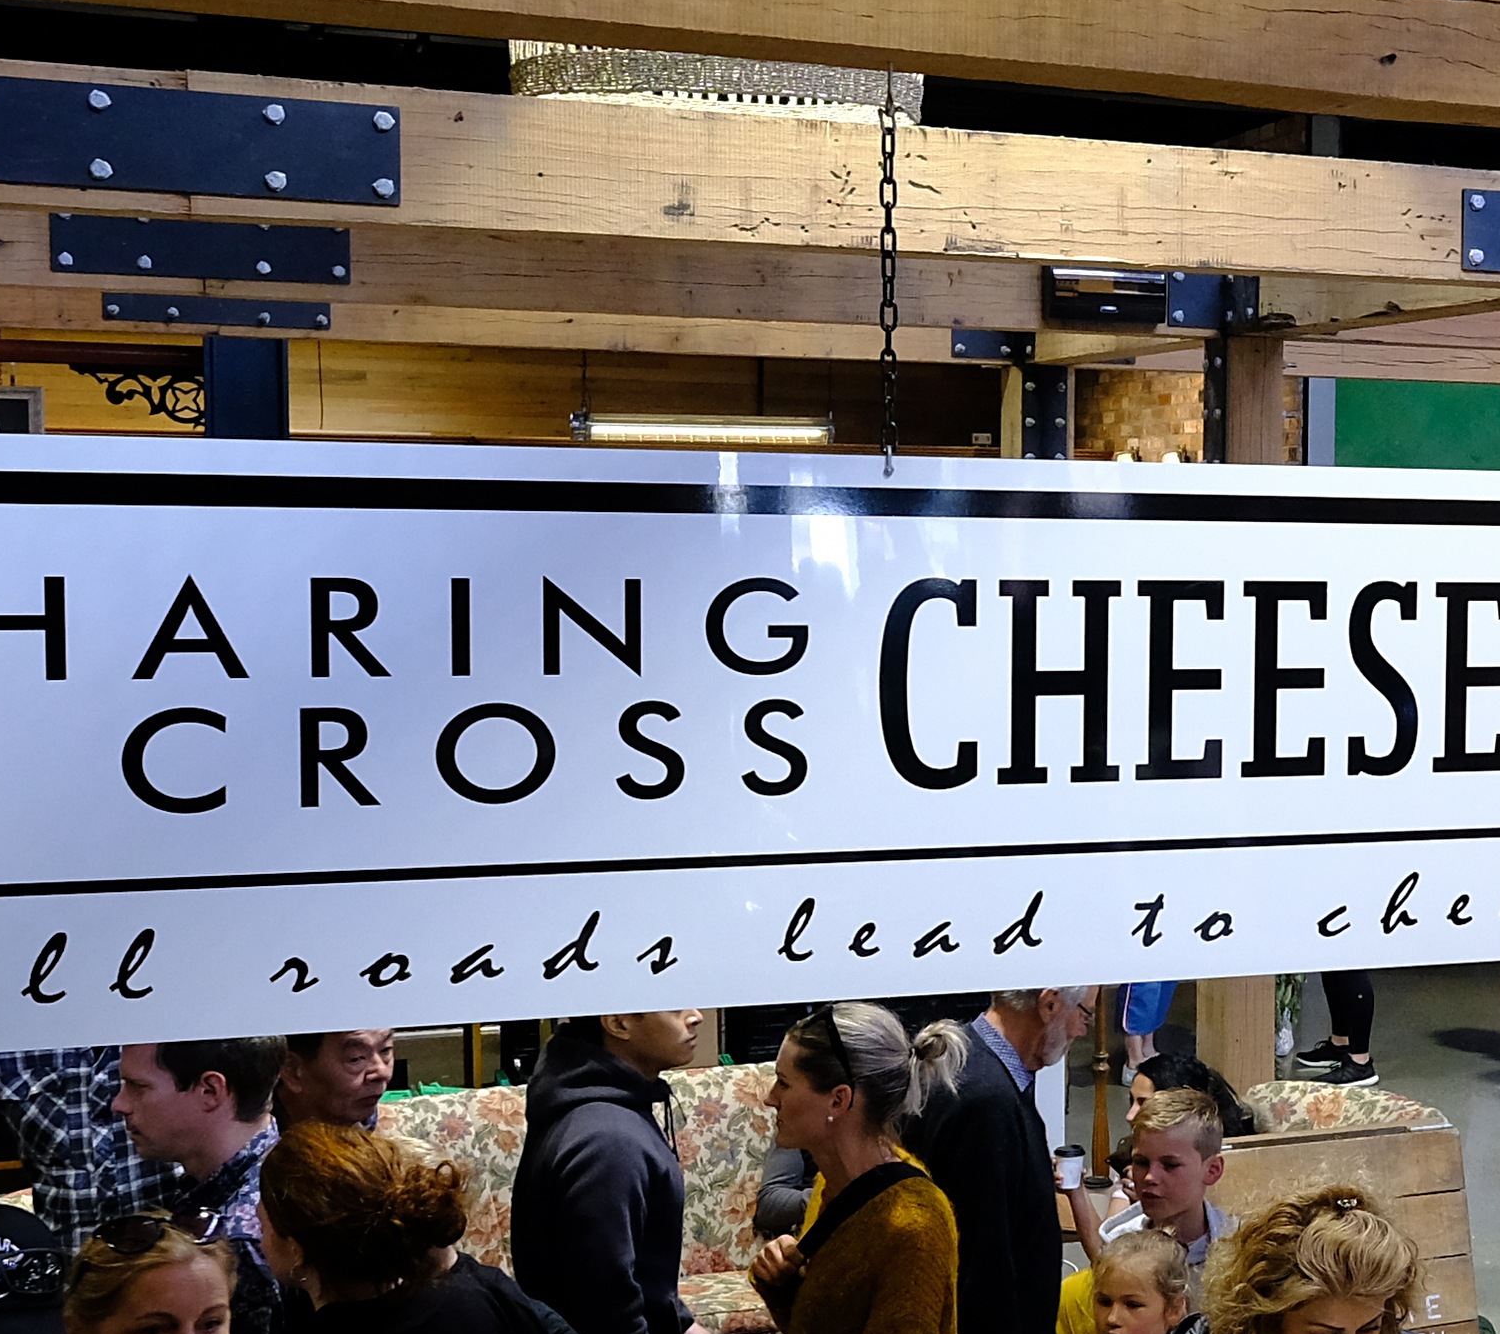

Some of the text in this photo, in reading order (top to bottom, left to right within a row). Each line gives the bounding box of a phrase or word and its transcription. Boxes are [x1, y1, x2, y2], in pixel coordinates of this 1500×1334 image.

[121, 699, 808, 814] CROSS
[269, 910, 678, 993] roads
[777, 890, 1044, 962] lead
[1131, 893, 1234, 947] to
